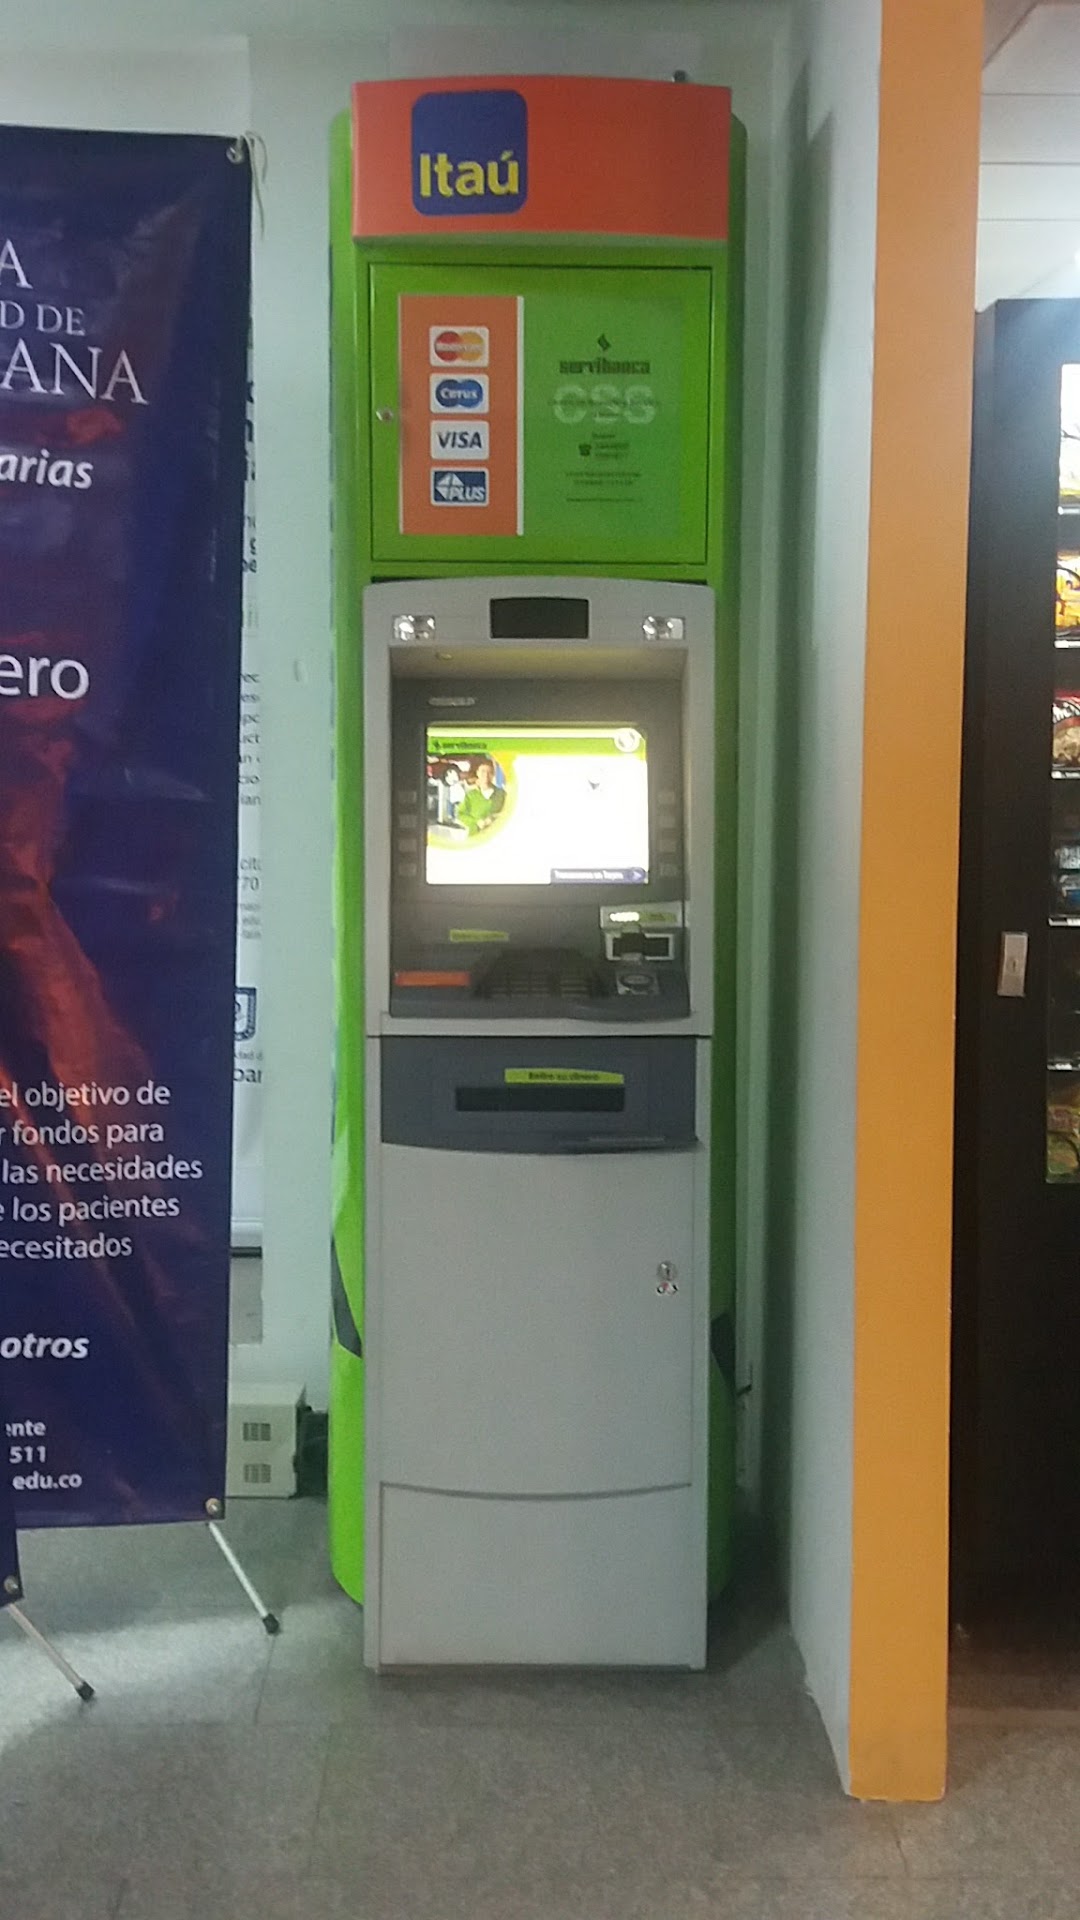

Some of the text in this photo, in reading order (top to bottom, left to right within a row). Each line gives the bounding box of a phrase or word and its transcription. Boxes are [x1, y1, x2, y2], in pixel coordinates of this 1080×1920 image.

[419, 149, 519, 198] Itaú
[0, 238, 33, 289] A
[0, 300, 86, 336] D DE
[0, 338, 149, 405] ANA
[553, 384, 656, 424] CSS
[437, 431, 483, 449] VISA
[0, 448, 94, 490] arias
[449, 485, 486, 501] PLUS
[0, 654, 89, 700] ero
[0, 1079, 171, 1112] el objetivo de
[13, 1119, 100, 1146] fondos
[106, 1122, 164, 1149] para
[2, 1154, 203, 1184] las necesidades
[13, 1196, 51, 1222] los
[58, 1194, 180, 1228] pacientes
[0, 1232, 132, 1260] ecesitados
[0, 1332, 90, 1359] otros
[9, 1446, 46, 1464] 511
[12, 1471, 83, 1490] edu.co
